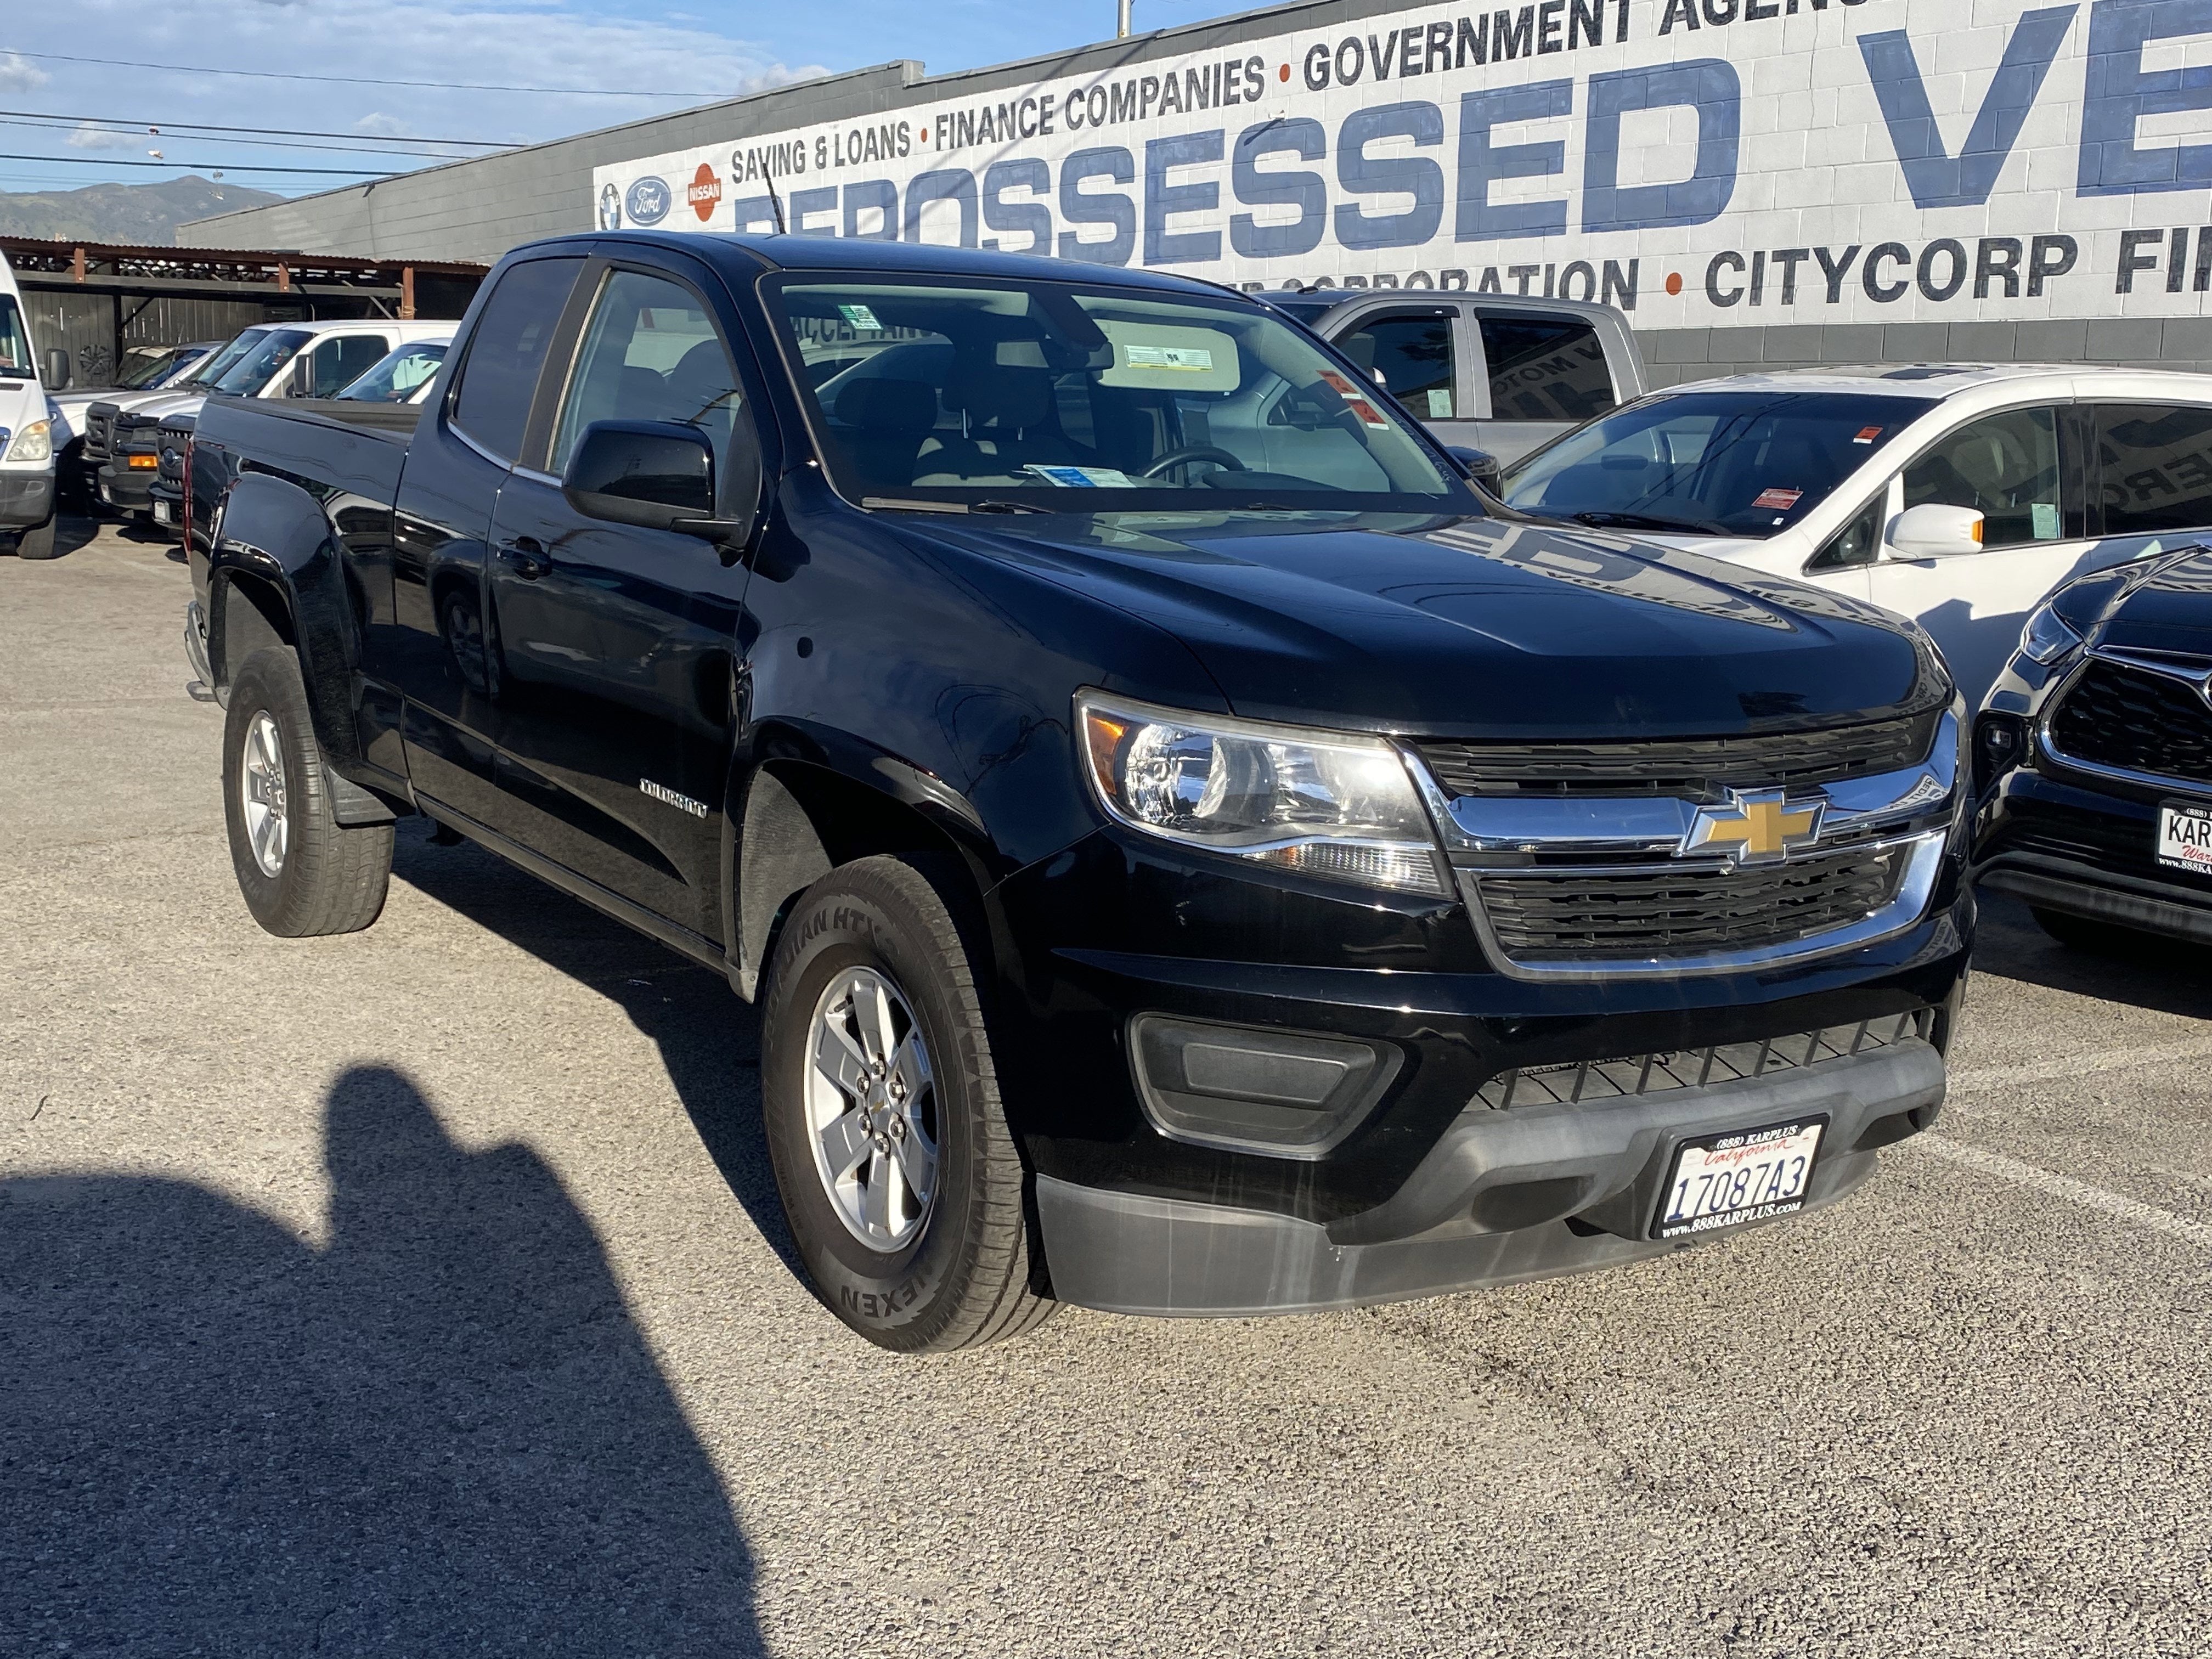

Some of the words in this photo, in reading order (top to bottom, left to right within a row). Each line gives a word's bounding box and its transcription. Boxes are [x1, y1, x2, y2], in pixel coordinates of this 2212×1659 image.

[732, 139, 805, 184] SAVING
[815, 136, 827, 170] &
[834, 120, 911, 167] LOANS
[936, 94, 1054, 151] FINANCE
[1065, 55, 1265, 130] COMPANIES
[1304, 0, 1628, 91] GOVERNMENT
[634, 187, 662, 215] Ford
[689, 183, 720, 201] NISSAN
[1705, 234, 2078, 308] CITYCORP
[2181, 845, 2212, 863] War
[1716, 1136, 1745, 1150] (888)
[1746, 1125, 1799, 1145] KARPLUS
[1704, 1138, 1796, 1167] California
[1667, 1155, 1806, 1221] 17087A3
